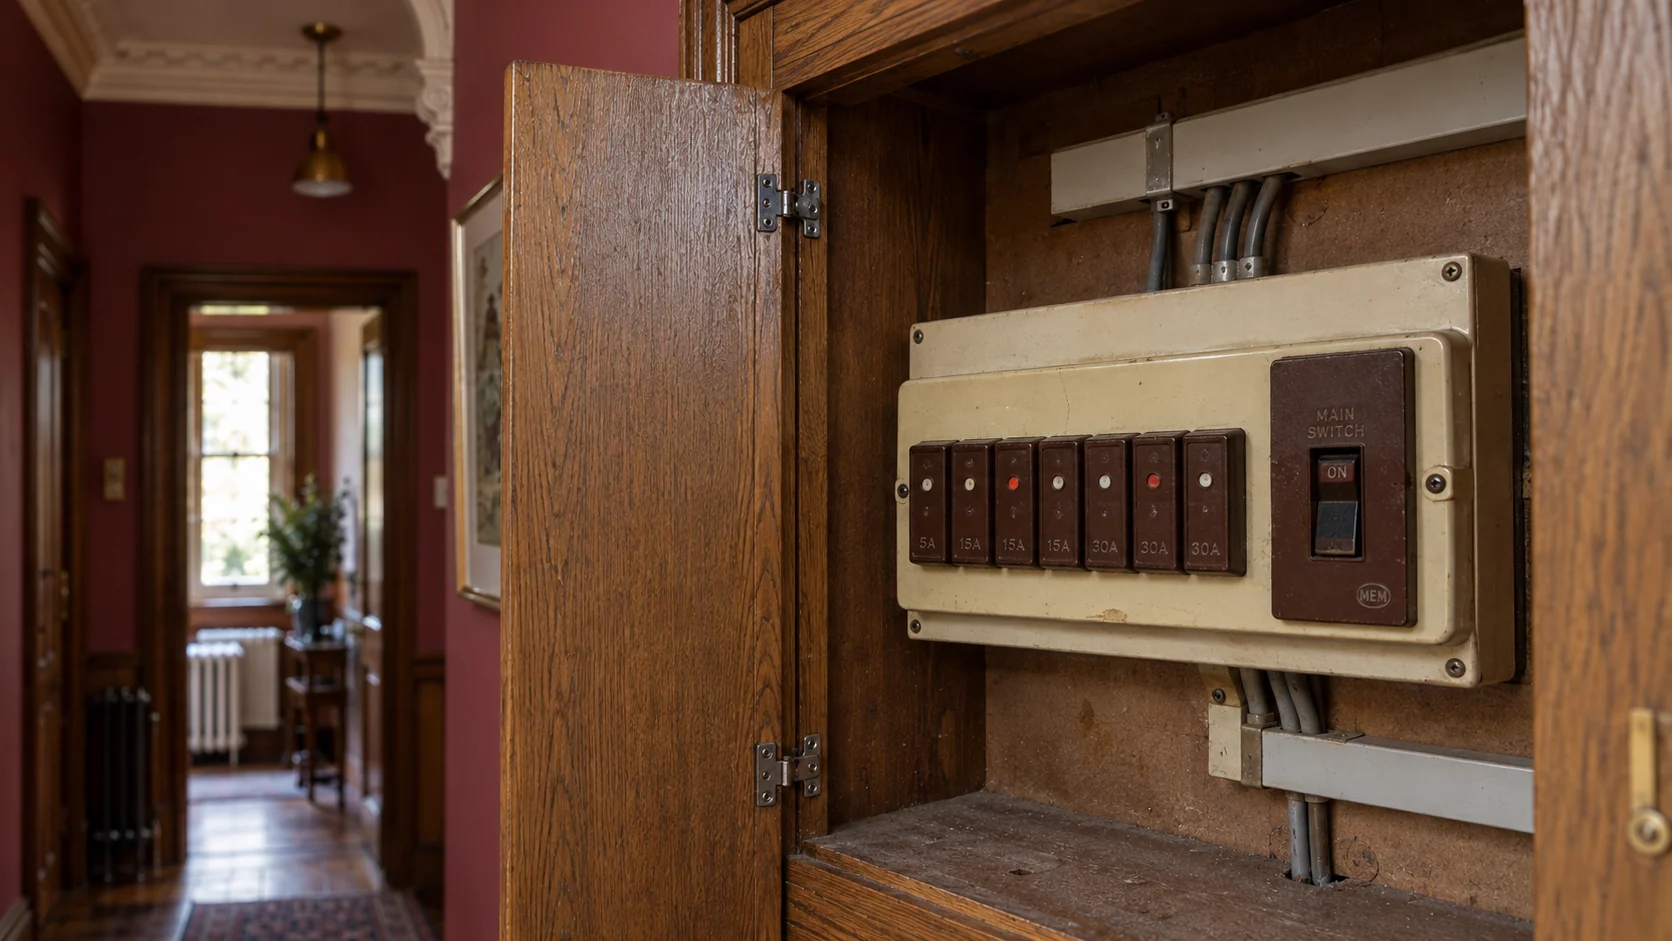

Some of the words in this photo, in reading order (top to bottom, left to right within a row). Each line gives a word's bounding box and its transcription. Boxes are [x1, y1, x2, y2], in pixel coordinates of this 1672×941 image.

[1317, 408, 1355, 422] MAIN
[1307, 424, 1364, 439] SWITCH
[1327, 465, 1347, 479] ON
[919, 537, 936, 549] 5A
[960, 537, 981, 550] 15A
[1003, 538, 1025, 551] 15A
[1047, 539, 1070, 552] 15A
[1092, 540, 1118, 553] 30A
[1141, 541, 1168, 554] 30A
[1192, 542, 1220, 555] 30A
[1359, 589, 1387, 603] MEM
